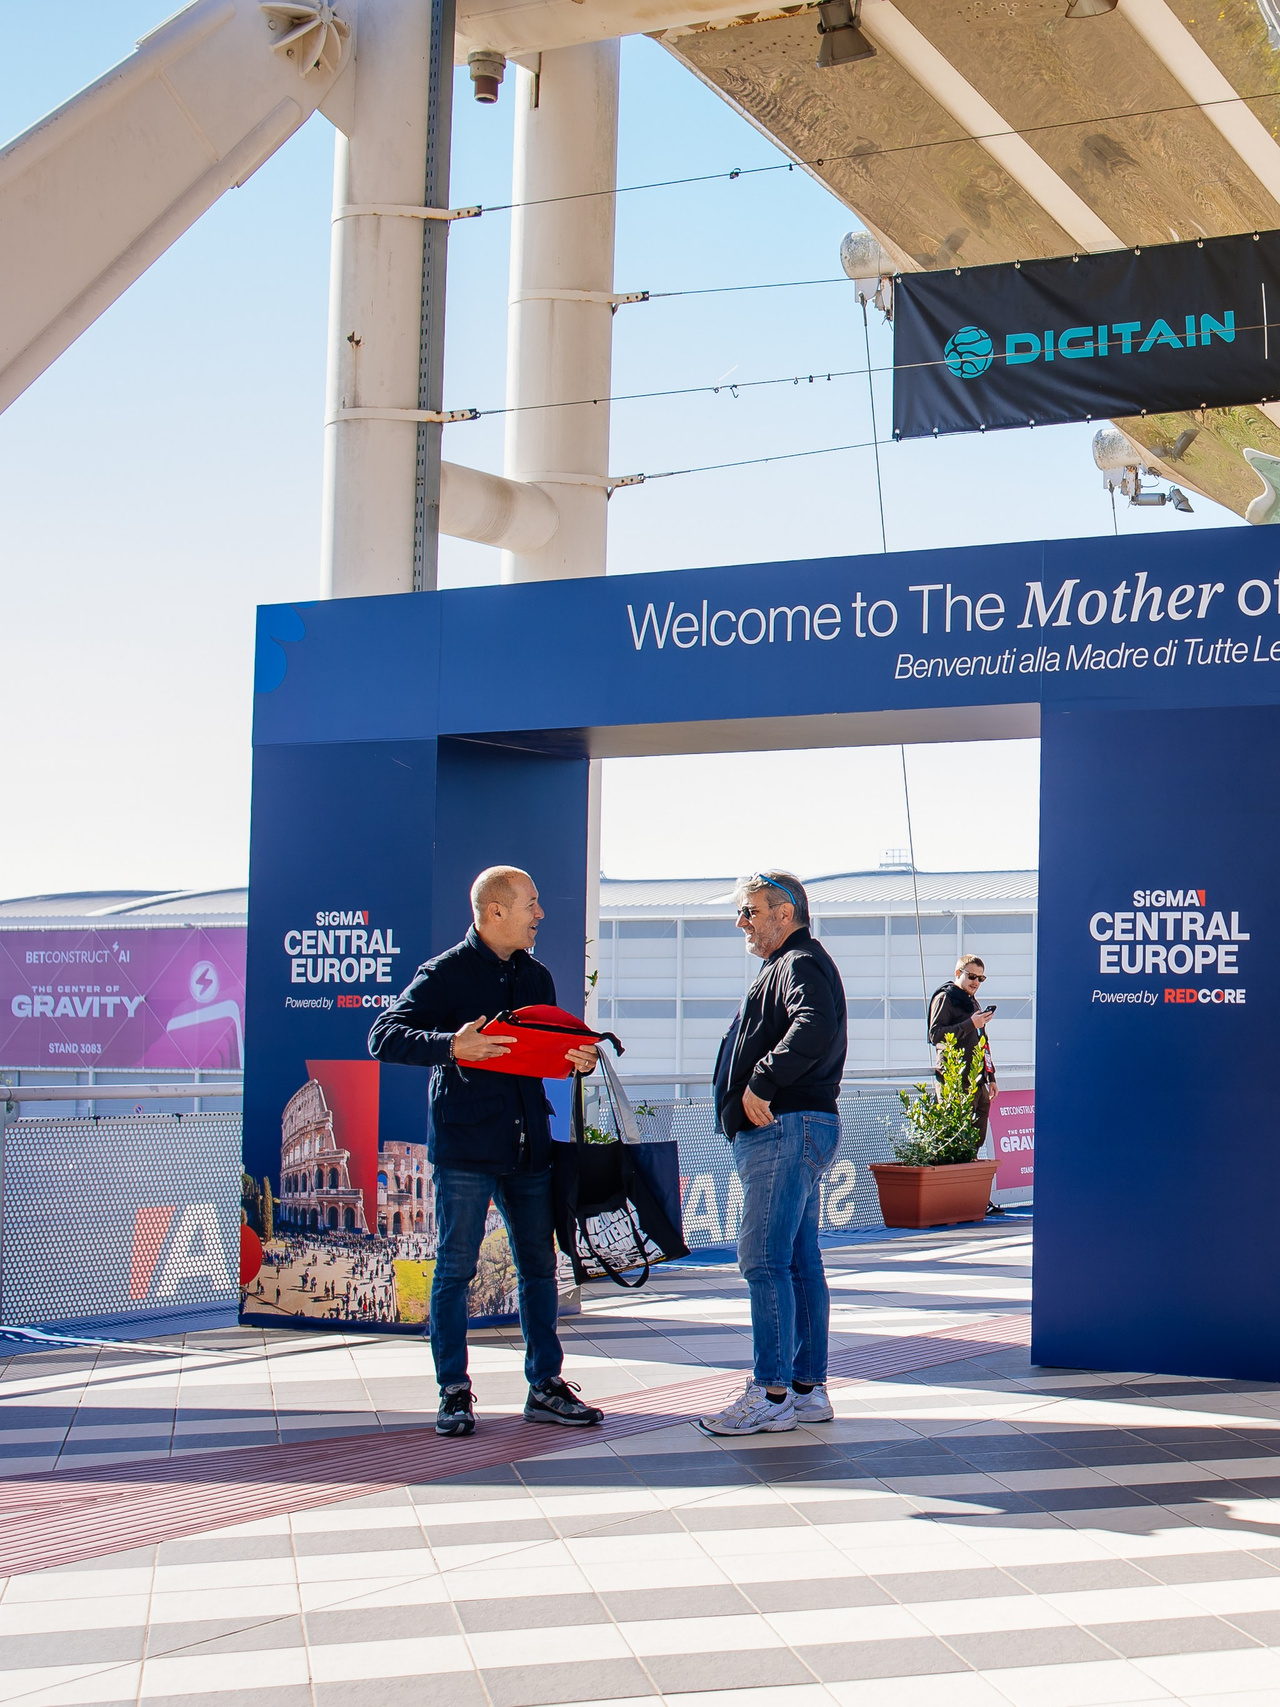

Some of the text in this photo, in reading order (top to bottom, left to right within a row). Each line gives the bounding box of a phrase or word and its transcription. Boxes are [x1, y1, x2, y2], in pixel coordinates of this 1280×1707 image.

[1005, 310, 1236, 365] DIGITAIN
[626, 599, 842, 651] Welcome
[852, 591, 898, 639] to
[909, 584, 1005, 635] The
[1017, 571, 1226, 629] Mother
[894, 648, 1016, 681] Benvenuti
[1018, 645, 1060, 673] alla
[1065, 641, 1148, 671] Madre
[1153, 638, 1178, 667] di
[1184, 635, 1249, 665] Tutte
[1133, 889, 1202, 908] SiGMA
[315, 911, 366, 927] SiGMA
[1089, 911, 1250, 942] CENTRAL
[284, 928, 401, 956] CENTRAL
[25, 950, 130, 964] BETCONSTRUCT AI
[1099, 944, 1239, 975] EUROPE
[291, 957, 393, 984] EUROPE
[32, 984, 120, 993] THE CENTER OF
[1091, 988, 1246, 1006] Powered by REDCORE
[11, 994, 145, 1019] GRAVITY
[285, 996, 321, 1008] Powered
[321, 996, 334, 1010] by
[48, 1043, 102, 1054] STAND 3083
